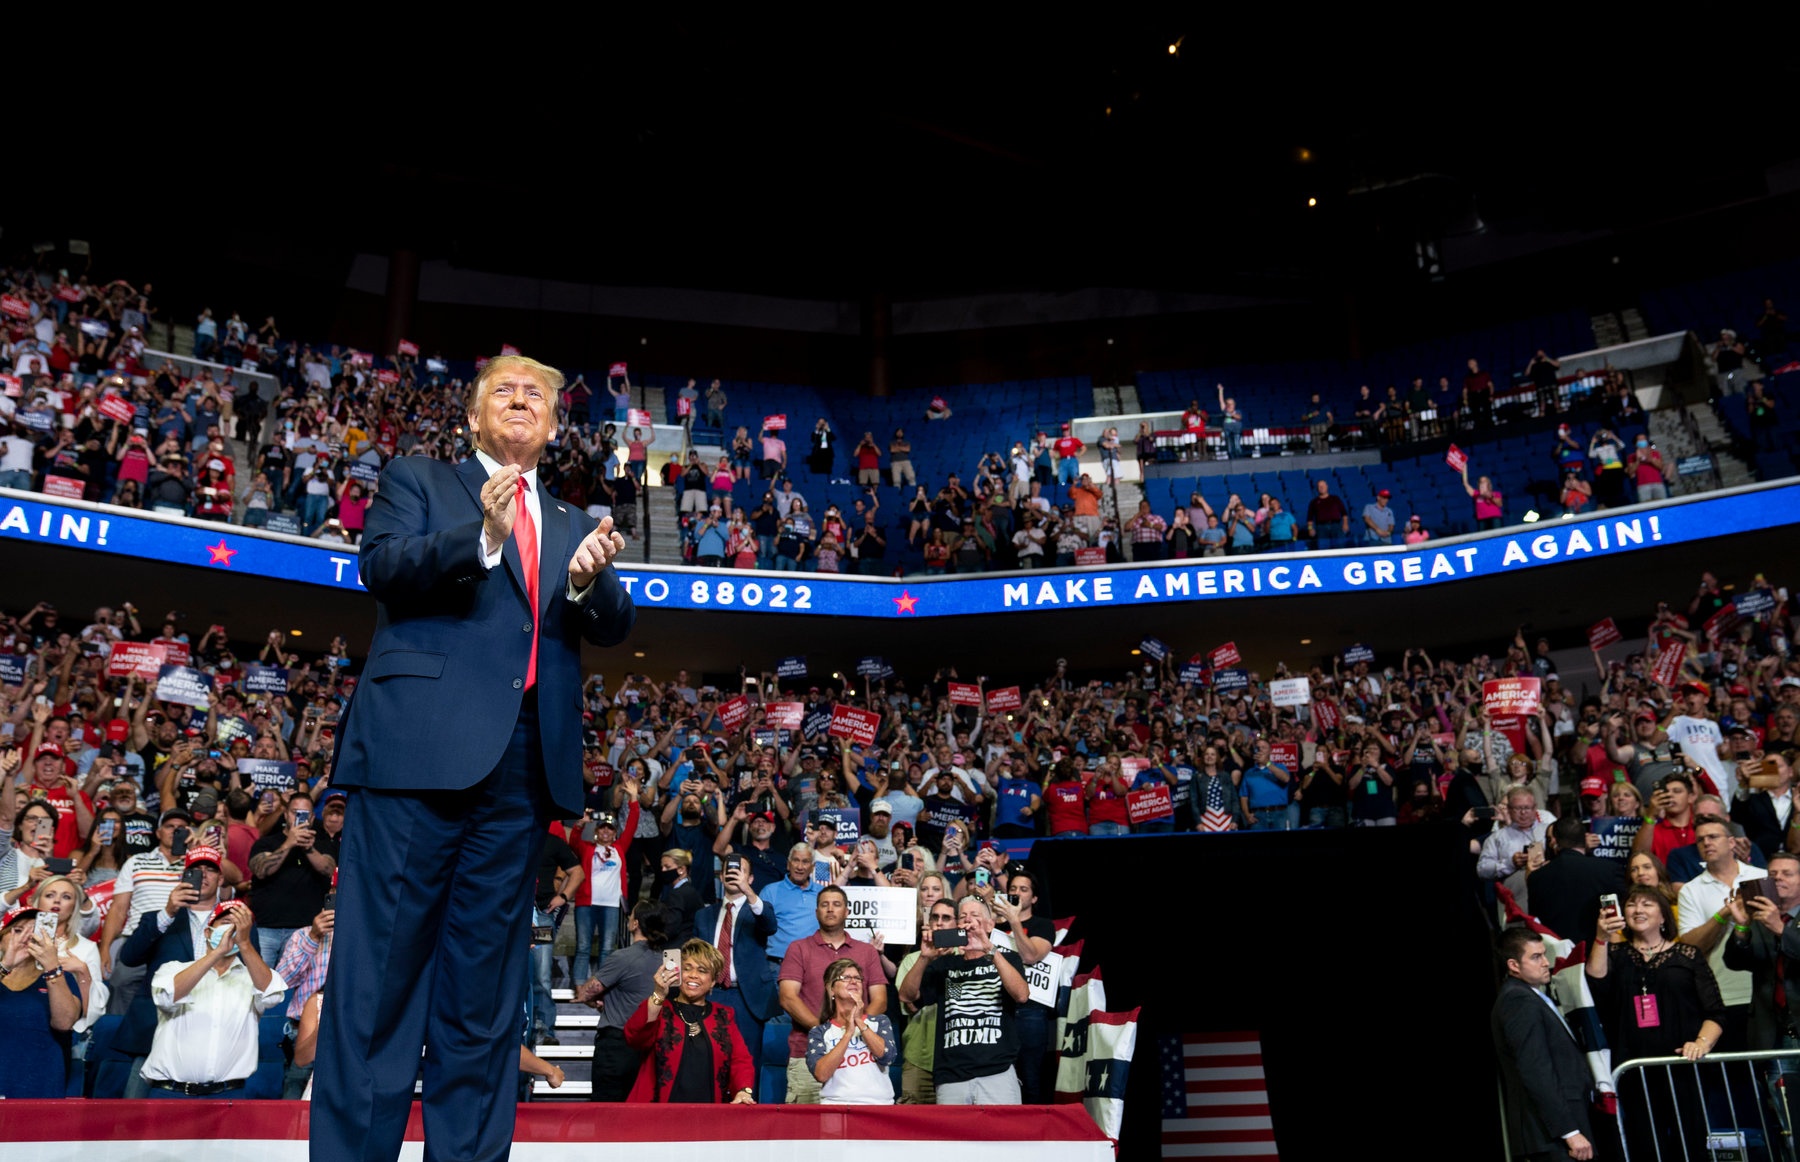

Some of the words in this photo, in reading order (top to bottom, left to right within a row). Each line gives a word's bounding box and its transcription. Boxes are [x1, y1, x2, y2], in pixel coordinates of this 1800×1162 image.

[1003, 577, 1113, 607] MAKE
[1134, 564, 1323, 599] AMERICA
[1343, 547, 1477, 586] GREAT
[1502, 515, 1662, 567] AGAIN!
[619, 576, 669, 601] TO
[691, 580, 812, 609] 88022
[127, 646, 149, 655] MAKE
[112, 653, 161, 666] AMERICA
[111, 662, 135, 670] GREAT
[777, 663, 806, 673] AMERICA
[175, 671, 199, 682] MAKE
[259, 670, 277, 678] MAKE
[1180, 671, 1199, 679] AMER
[247, 675, 286, 686] AMERICA
[1216, 675, 1247, 684] AMERICA
[159, 676, 211, 694] AMERICA
[247, 683, 266, 691] GREAT
[267, 684, 286, 692] AGAIN
[1498, 682, 1522, 690] MAKE
[951, 690, 979, 698] AMERICA
[1273, 687, 1307, 697] AMERICA
[1484, 689, 1537, 702] AMERICA
[989, 694, 1018, 704] AMERICA
[1486, 700, 1510, 709] GREAT
[1510, 698, 1538, 708] AGAIN
[767, 710, 801, 720] AMERICA
[847, 711, 866, 721] MAKE
[833, 715, 875, 733] AMERICA
[832, 724, 853, 734] GREAT
[852, 729, 873, 740] AGAIN
[38, 742, 59, 752] USA
[255, 765, 279, 774] MAKE
[1139, 791, 1157, 800] MAKE
[1131, 796, 1169, 812] AMERICA
[940, 807, 960, 815] MAKE
[1131, 807, 1151, 818] GREAT
[1151, 804, 1171, 814] AGAIN
[1593, 847, 1630, 858] GREAT
[846, 900, 879, 916] COPS
[845, 919, 867, 928] FOR
[1026, 969, 1051, 991] COP
[949, 1017, 976, 1030] STAND
[977, 1016, 1001, 1028] WITH
[943, 1026, 1003, 1049] TRUMP
